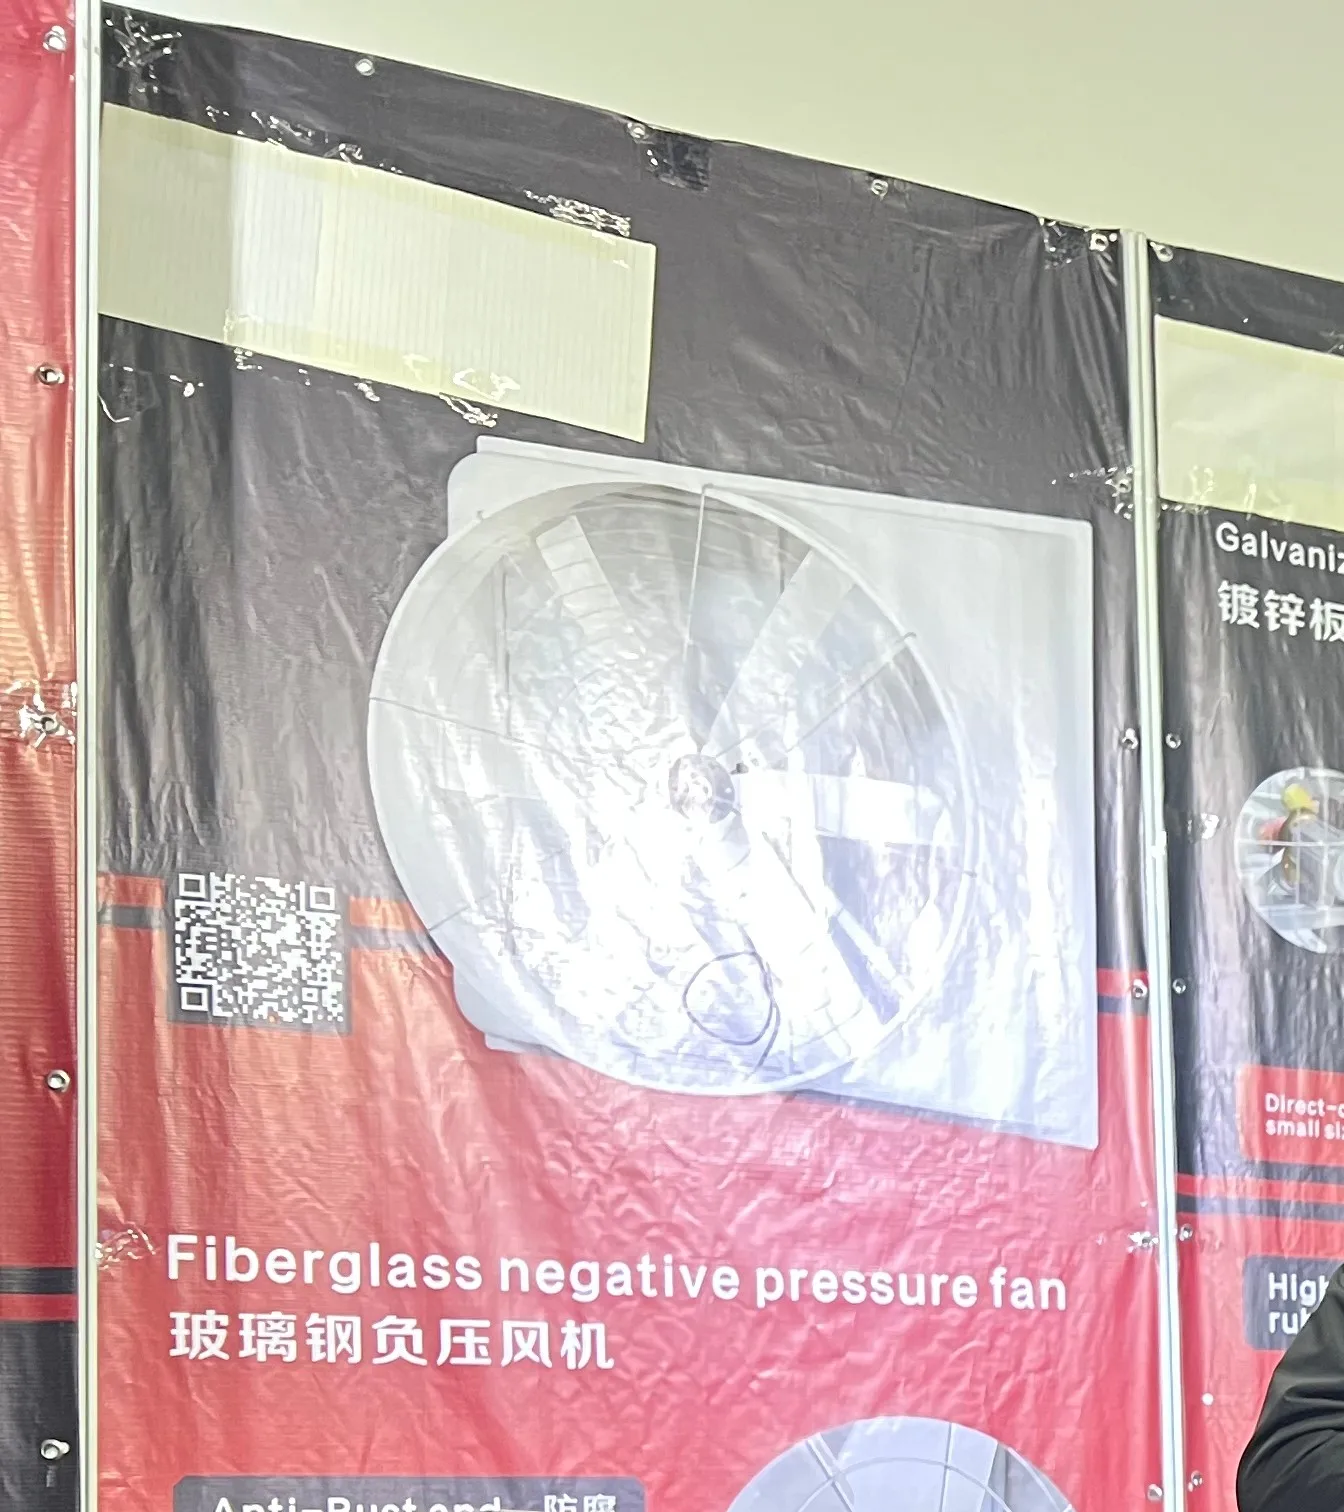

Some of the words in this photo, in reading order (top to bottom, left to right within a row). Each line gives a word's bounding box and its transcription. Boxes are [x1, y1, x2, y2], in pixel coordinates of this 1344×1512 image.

[1265, 1119, 1320, 1138] small
[166, 1233, 484, 1295] Fiberglass
[499, 1251, 742, 1304] negative
[755, 1260, 979, 1309] pressure
[990, 1265, 1068, 1311] fan
[168, 1307, 616, 1371] 玻璃钢负压风机
